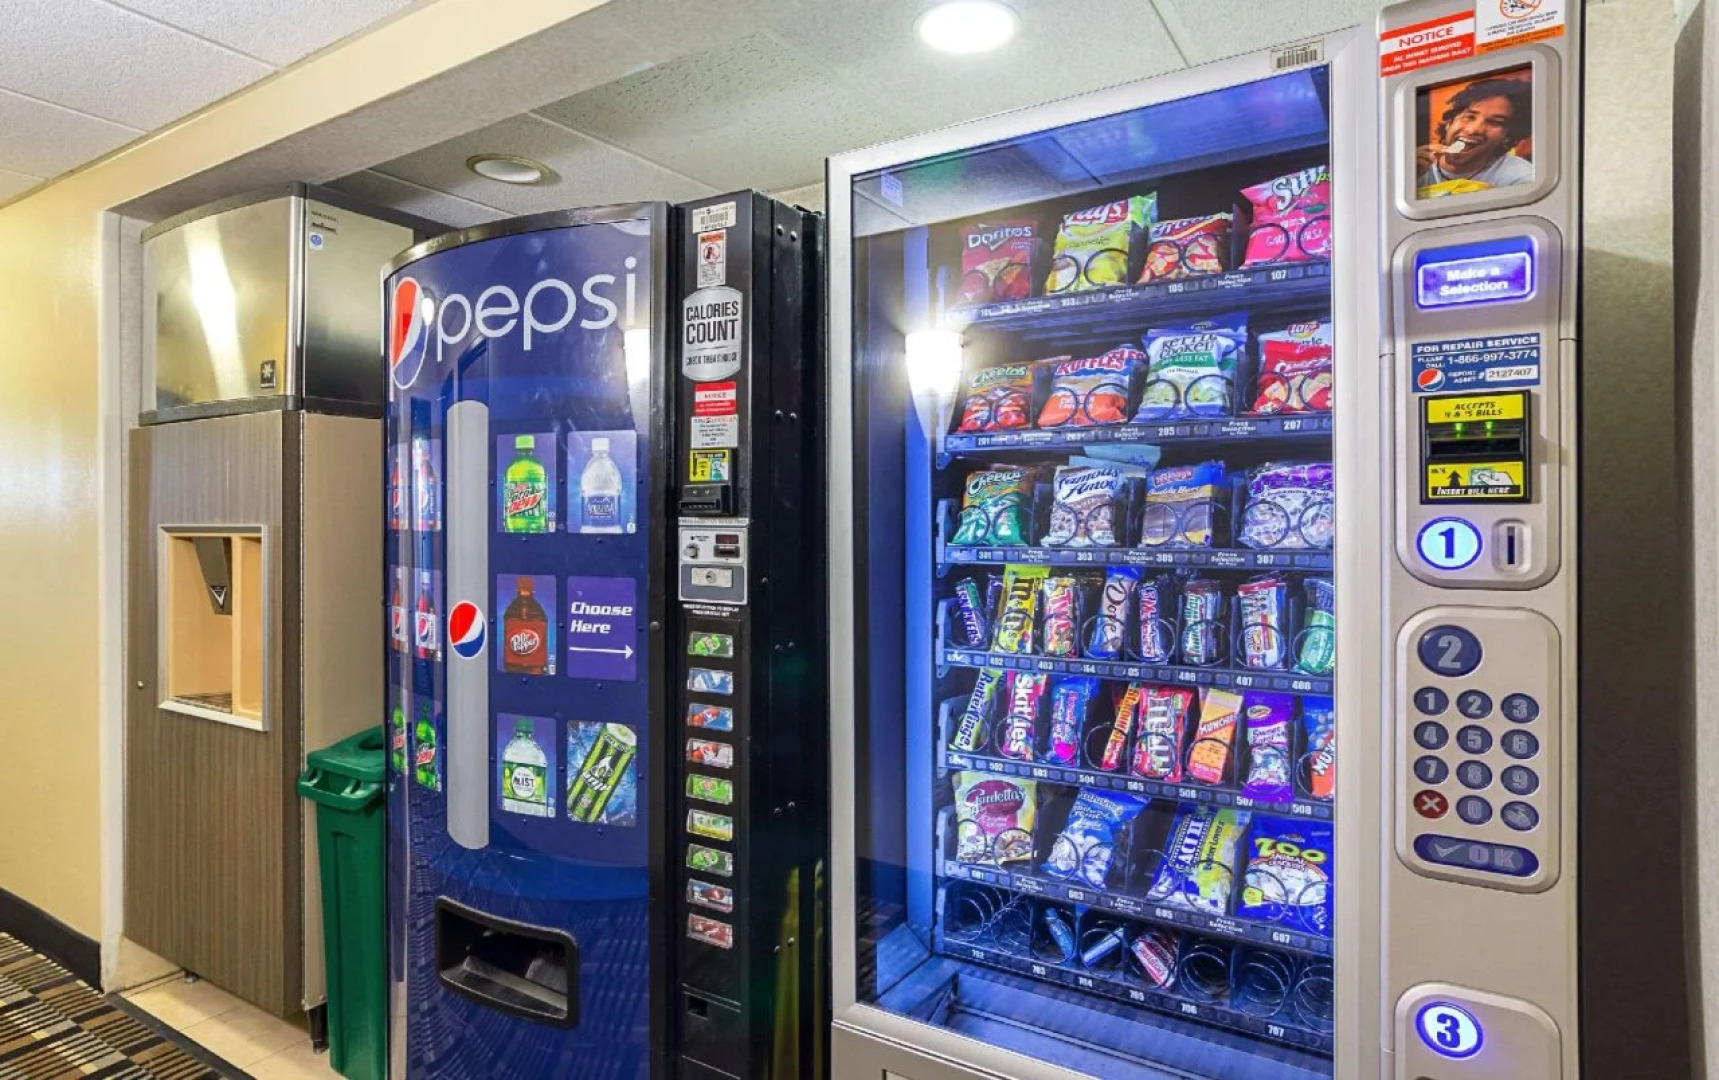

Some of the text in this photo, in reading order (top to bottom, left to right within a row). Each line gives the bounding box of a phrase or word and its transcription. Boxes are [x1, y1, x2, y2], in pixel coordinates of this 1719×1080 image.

[1399, 27, 1453, 48] NOTICE
[968, 226, 1032, 249] Doritos
[1271, 270, 1286, 280] 107
[1447, 267, 1500, 281] Make a
[1168, 283, 1184, 292] 105
[1440, 281, 1508, 296] Selection
[437, 256, 637, 361] pepsi
[686, 301, 739, 321] CALORIES
[686, 319, 738, 344] COUNT
[1417, 336, 1538, 353] FOR REPAIR SERVICE
[1448, 350, 1537, 365] 1-866-997-3774
[1454, 402, 1496, 410] ACCEPTS
[1476, 408, 1503, 417] BILLS
[1158, 427, 1175, 437] 205
[1284, 420, 1301, 430] 207
[968, 469, 1026, 498] Cheetos
[1058, 468, 1118, 490] Famous
[1062, 480, 1116, 500] Amos
[1437, 487, 1466, 495] INSERT
[1438, 527, 1455, 559] 1
[1077, 552, 1092, 561] 303
[1156, 553, 1173, 563] 305
[1257, 554, 1274, 564] 307
[571, 602, 633, 616] Choose
[1104, 577, 1128, 633] Dove
[571, 619, 611, 634] Here
[510, 634, 538, 651] Pepper
[1438, 635, 1462, 669] 2
[1038, 660, 1053, 670] 403
[1236, 677, 1253, 687] 407
[1010, 673, 1034, 750] Skittles
[1424, 692, 1528, 718] 1 2 3
[1423, 726, 1528, 753] 4 5 6
[1034, 767, 1048, 777] 503
[1080, 774, 1095, 784] 504
[1426, 760, 1528, 788] 7 8 9
[513, 777, 535, 788] MIST
[1179, 789, 1196, 798] 506
[1292, 804, 1312, 814] 508
[1255, 837, 1326, 863] ZOO
[1468, 844, 1515, 868] OK
[1272, 931, 1290, 943] 607
[1268, 1024, 1285, 1037] 707
[1436, 1013, 1461, 1049] 3
